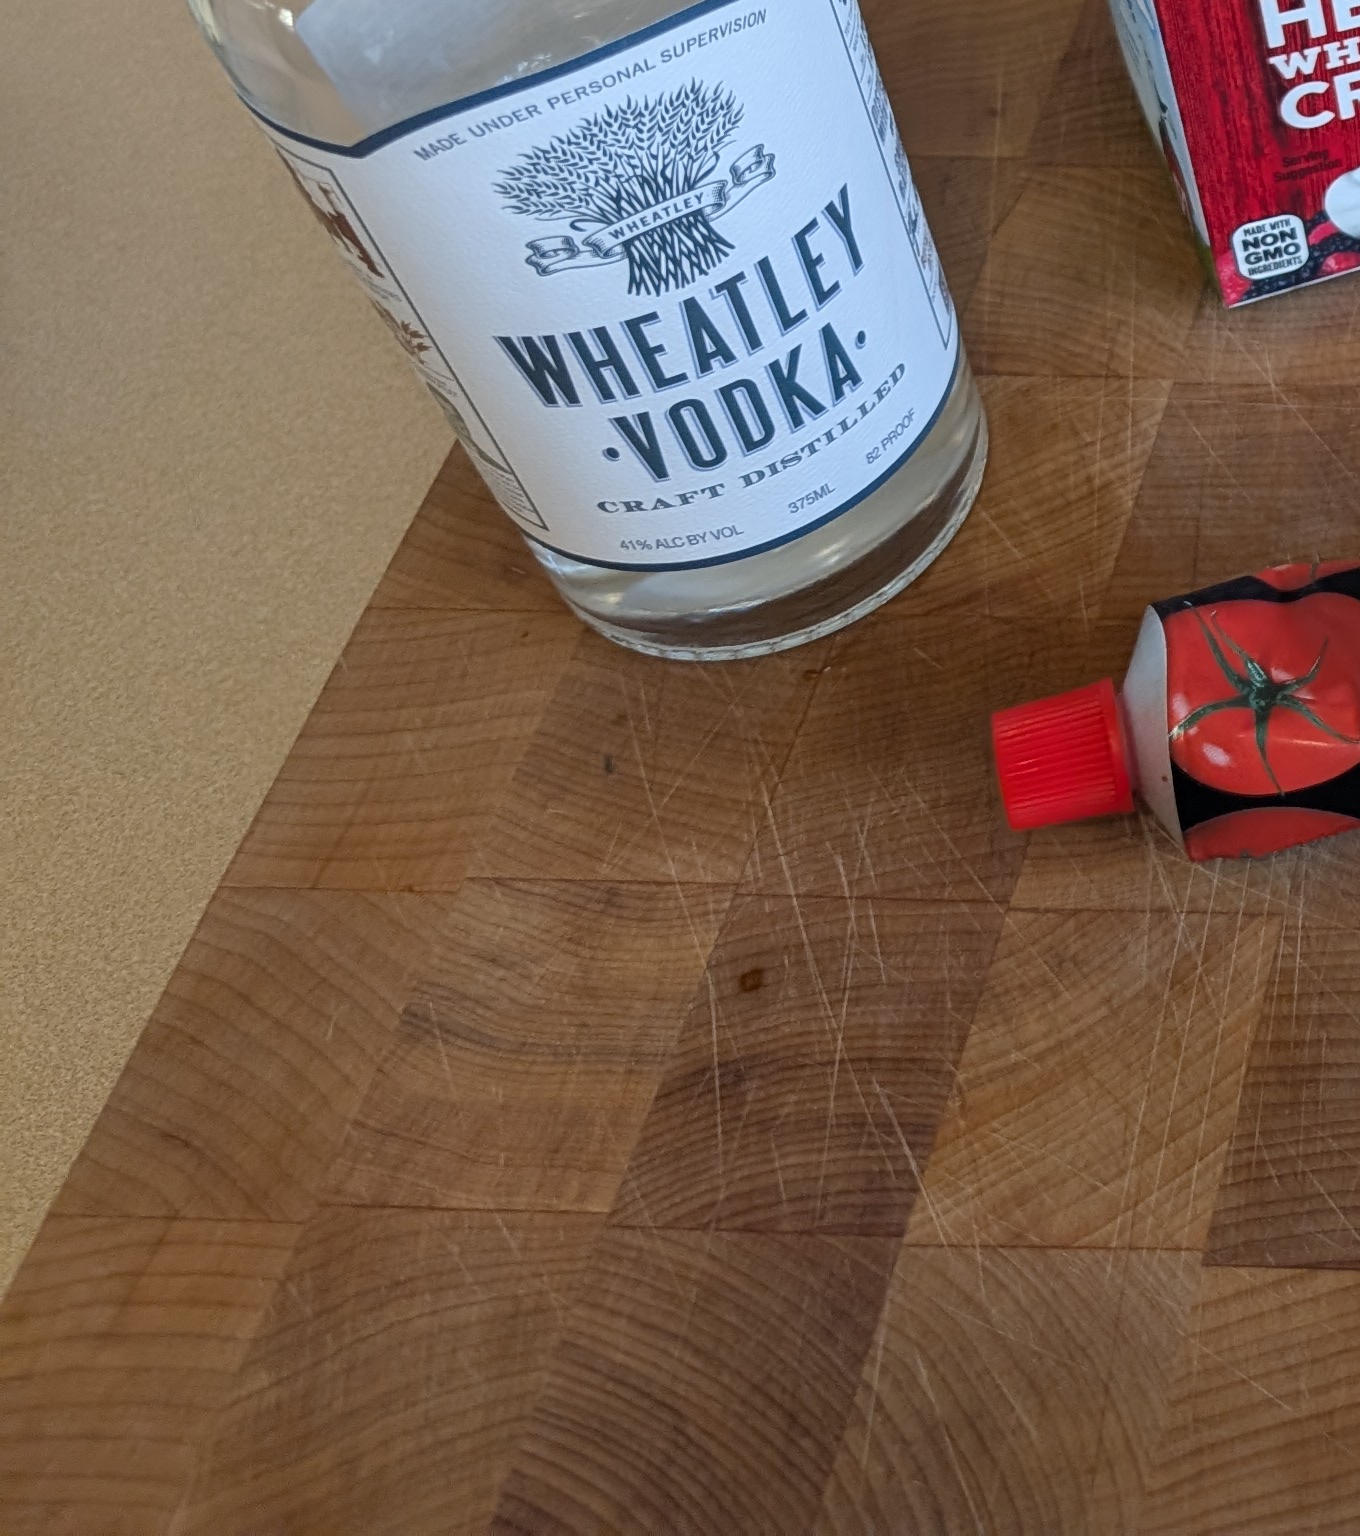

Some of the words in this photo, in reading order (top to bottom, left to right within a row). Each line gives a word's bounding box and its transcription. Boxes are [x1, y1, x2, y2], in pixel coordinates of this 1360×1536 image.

[413, 133, 467, 161] MADE
[467, 105, 543, 138] UNDER
[547, 58, 657, 110] PERSONAL
[660, 9, 768, 64] SUPERVISION
[608, 193, 704, 240] WHEATLEY
[1243, 224, 1268, 236] MADE
[1270, 219, 1291, 230] WITH
[1241, 227, 1298, 252] NON
[1245, 243, 1301, 265] GMO
[1248, 257, 1303, 276] INGREDIENTS
[493, 183, 865, 408] WHEATLEY
[597, 483, 726, 514] CRAFT
[739, 362, 906, 489] DISTILLED
[865, 446, 881, 465] 82
[879, 408, 916, 456] PROOF
[788, 483, 836, 514] 375ML
[619, 538, 653, 551] 41%
[655, 535, 686, 550] ALC
[685, 532, 708, 547] BY
[711, 524, 745, 542] VOL
